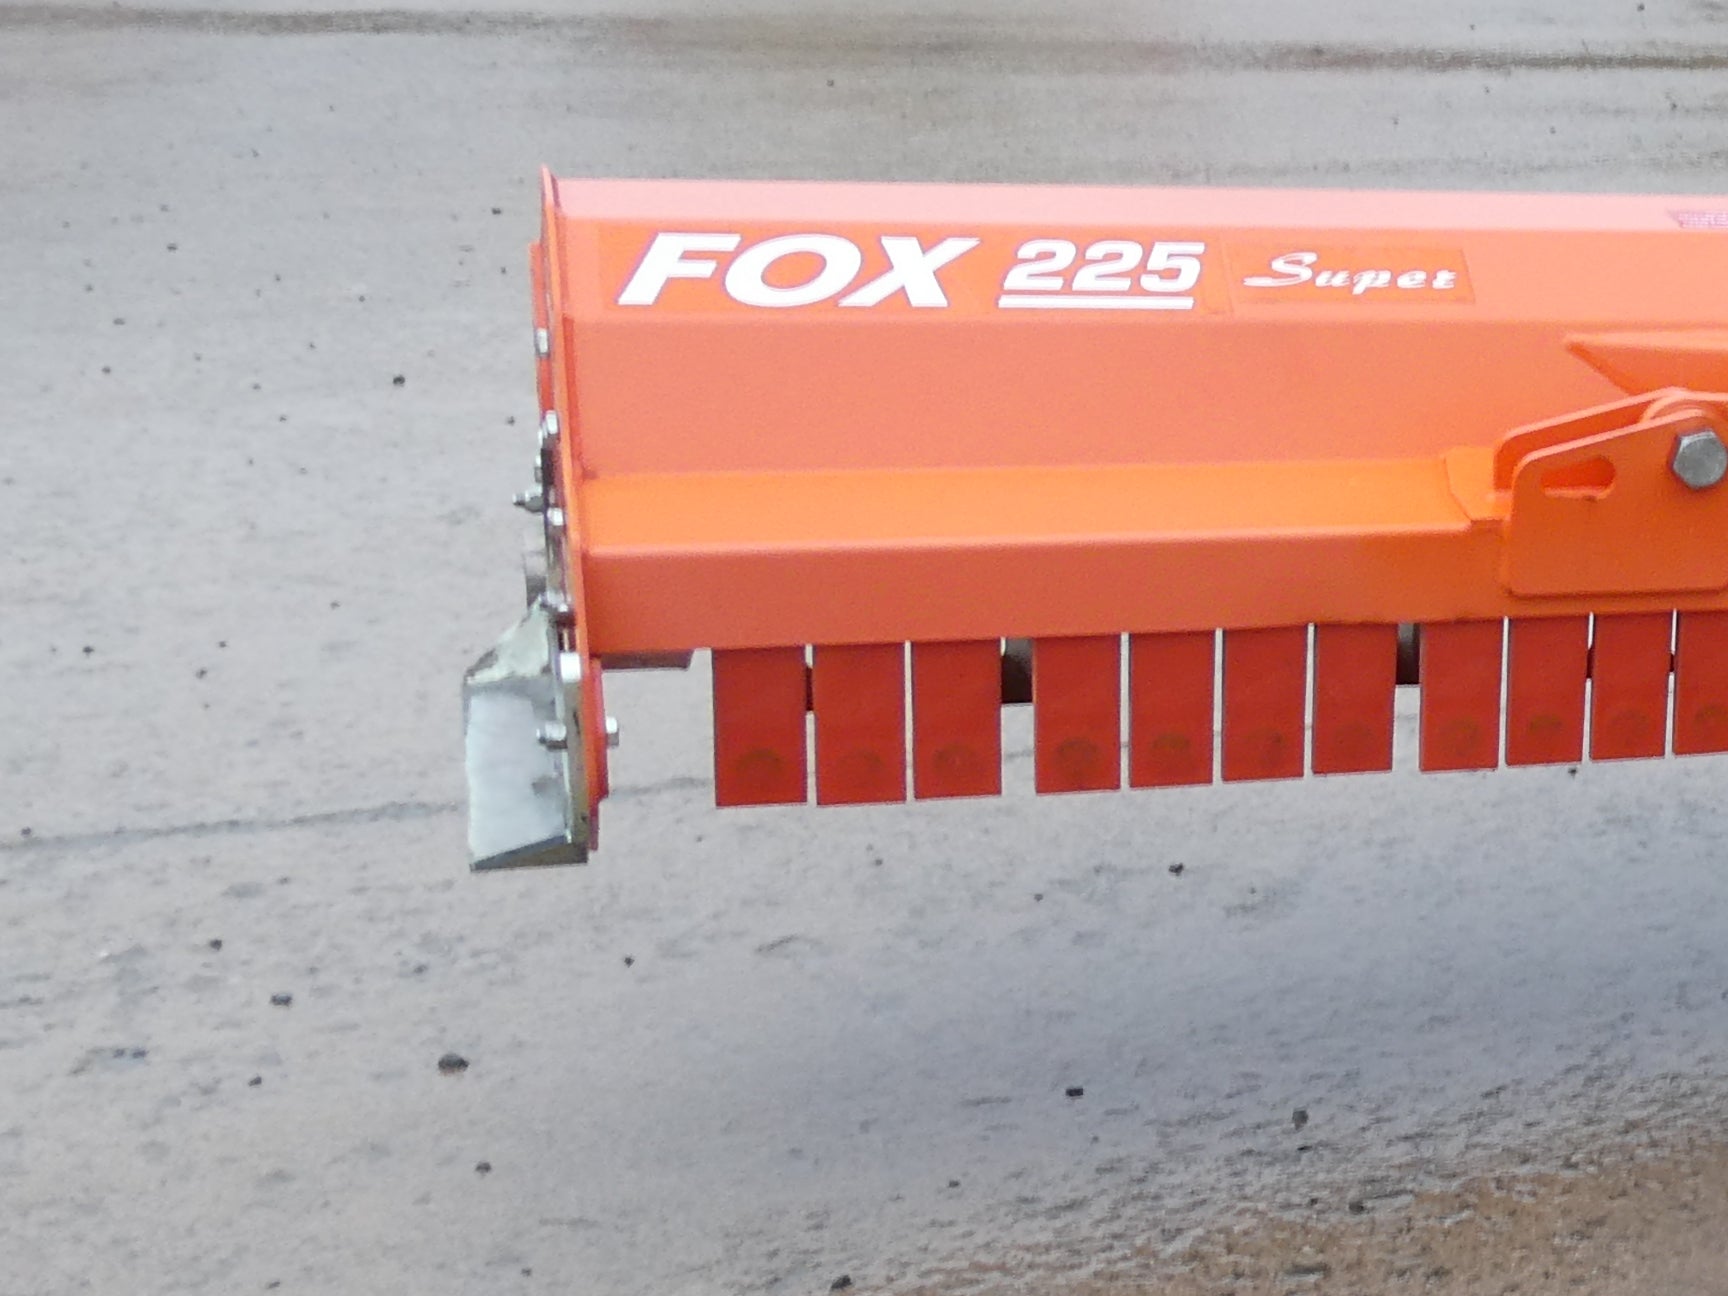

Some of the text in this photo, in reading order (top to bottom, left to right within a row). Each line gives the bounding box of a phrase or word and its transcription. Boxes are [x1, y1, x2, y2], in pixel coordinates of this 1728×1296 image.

[616, 232, 1458, 308] FOX 225 Super
